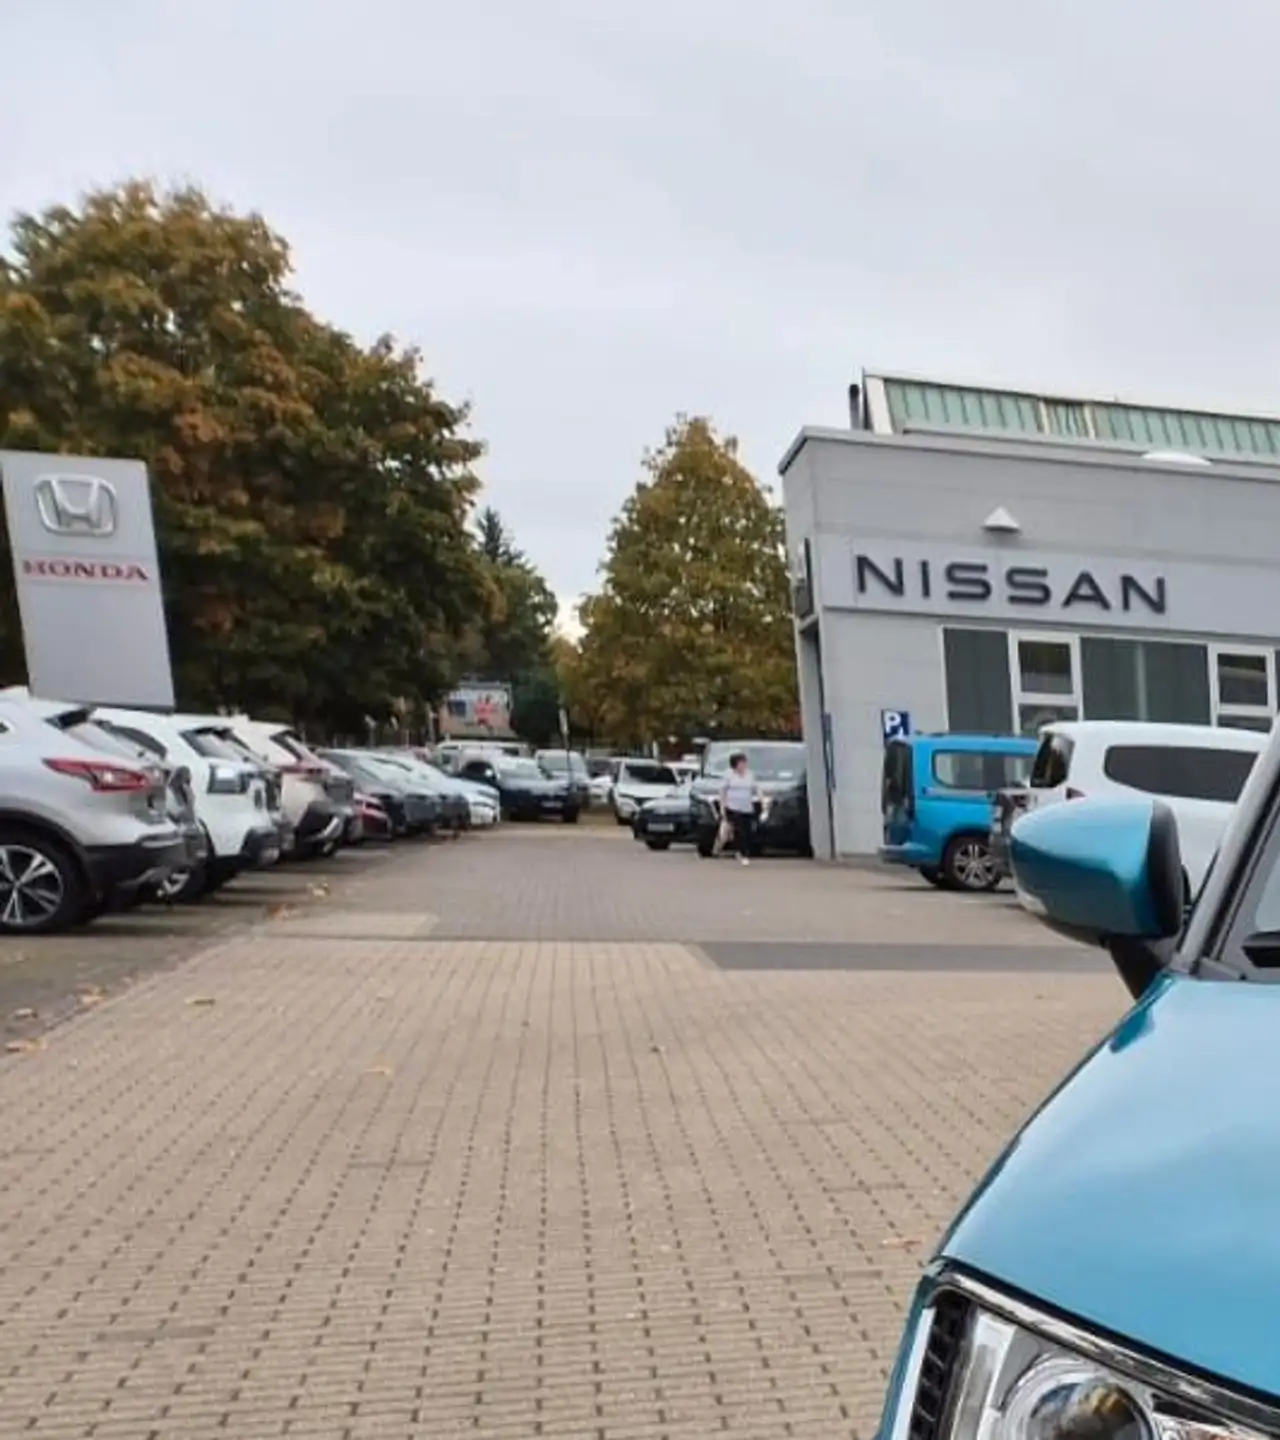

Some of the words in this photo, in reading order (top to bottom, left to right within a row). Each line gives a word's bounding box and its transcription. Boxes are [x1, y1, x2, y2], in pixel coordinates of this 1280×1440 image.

[22, 559, 148, 580] HONDA
[856, 555, 1166, 614] NISSAN
[884, 711, 900, 733] P
